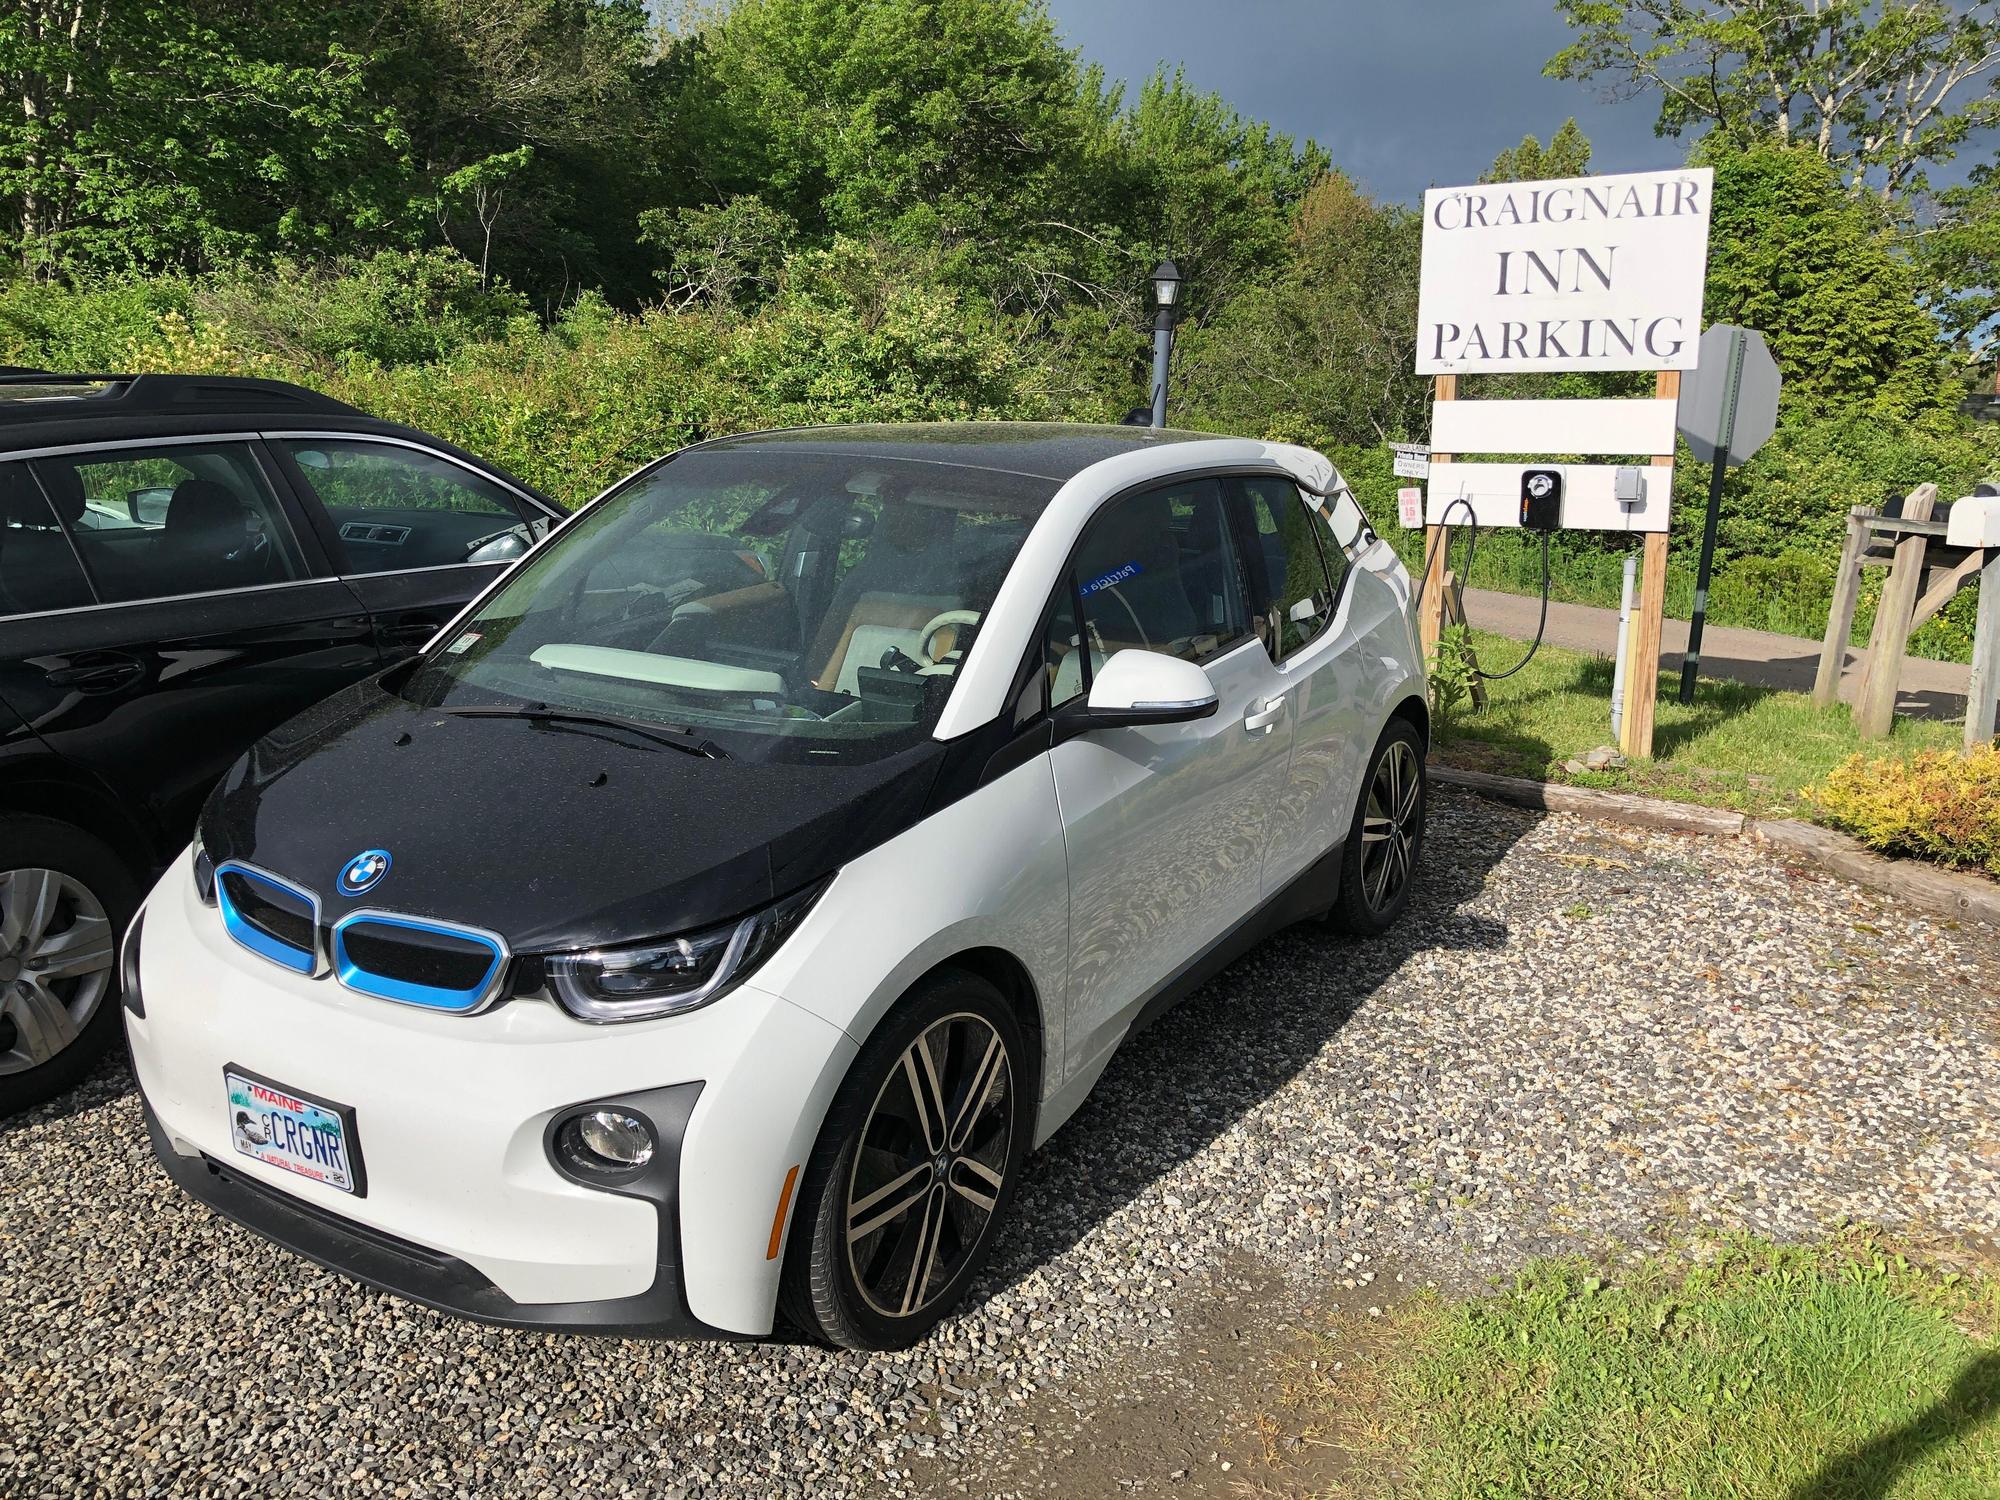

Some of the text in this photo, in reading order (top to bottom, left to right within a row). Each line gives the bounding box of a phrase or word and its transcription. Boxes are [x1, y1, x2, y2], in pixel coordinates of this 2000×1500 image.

[1433, 180, 1700, 231] CRAIGNAIR
[1493, 245, 1619, 295] INN
[1431, 316, 1686, 361] PARKING
[1397, 460, 1425, 469] OWNERS
[1405, 507, 1416, 516] 15
[253, 1087, 304, 1115] MAINE
[271, 1111, 343, 1171] CRGNR
[266, 1154, 291, 1170] NATURAL
[294, 1162, 325, 1181] TREASURE
